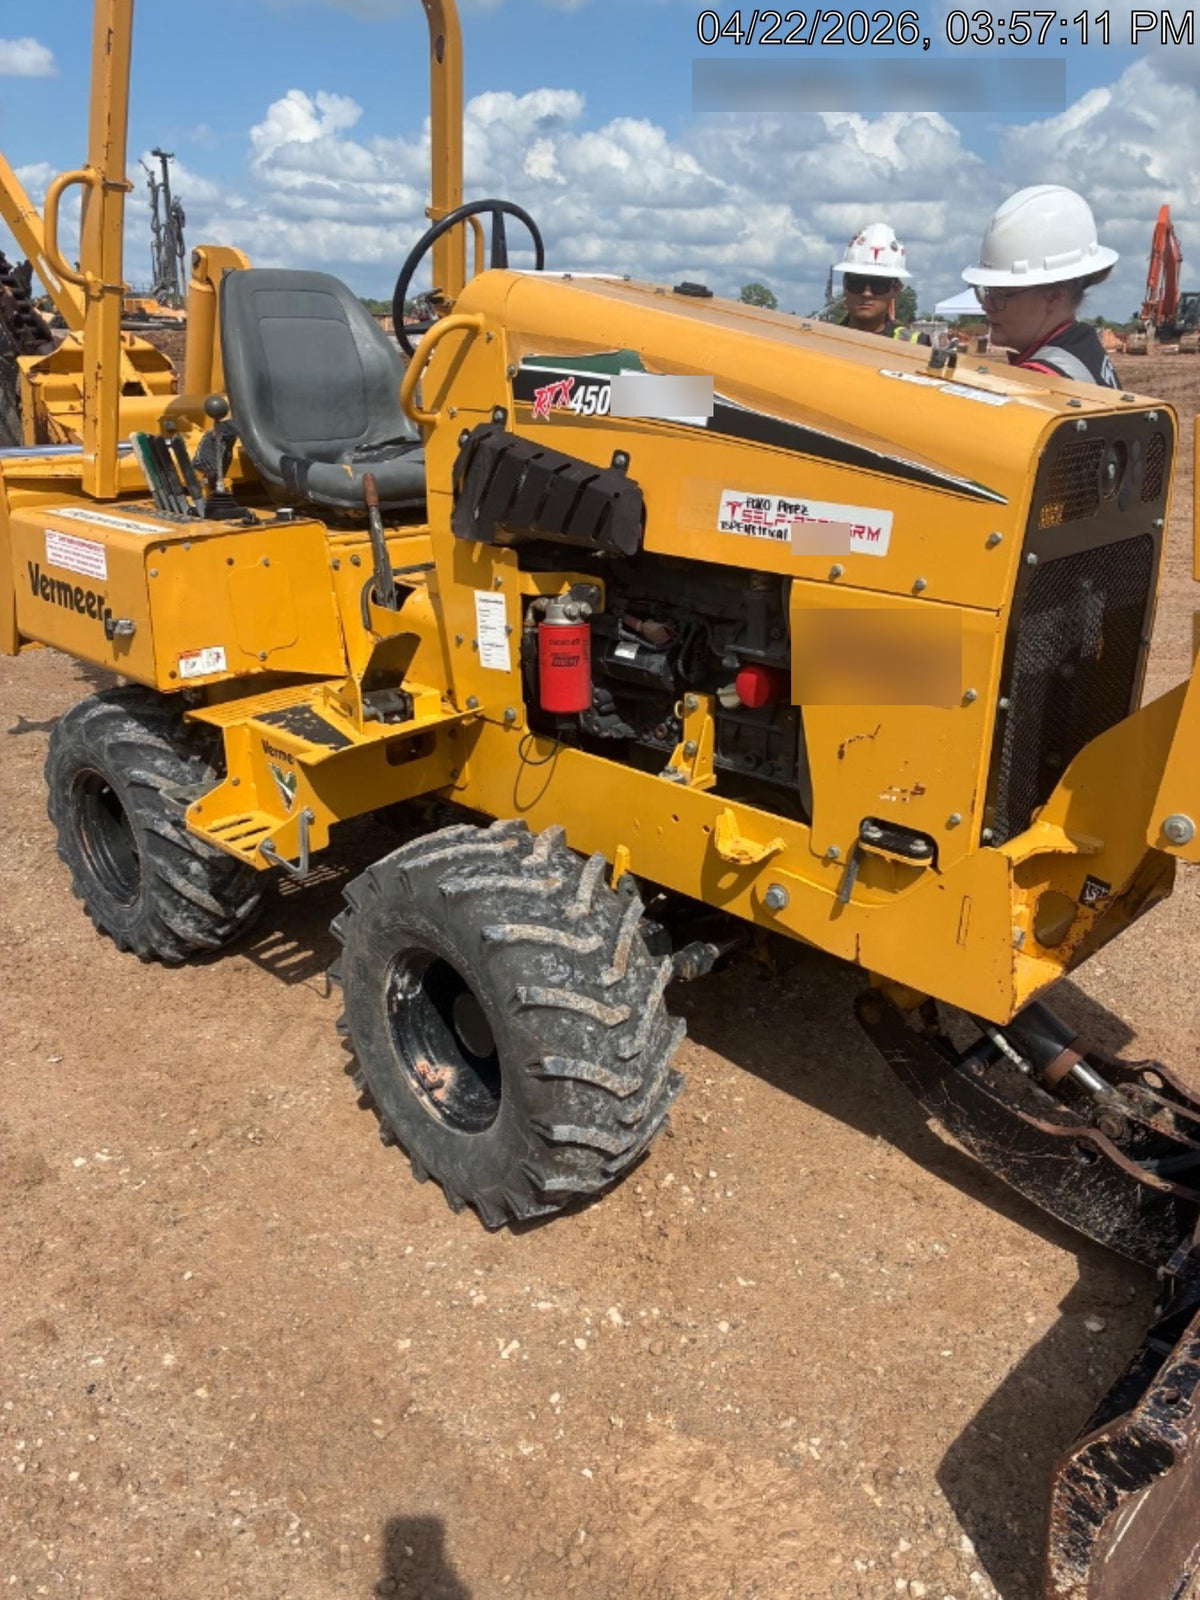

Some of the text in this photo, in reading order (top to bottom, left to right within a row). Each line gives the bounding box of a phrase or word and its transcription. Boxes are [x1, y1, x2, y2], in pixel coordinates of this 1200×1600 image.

[742, 509, 882, 542] SELF-RM
[28, 560, 105, 621] Vermeer
[261, 738, 295, 767] Verme
